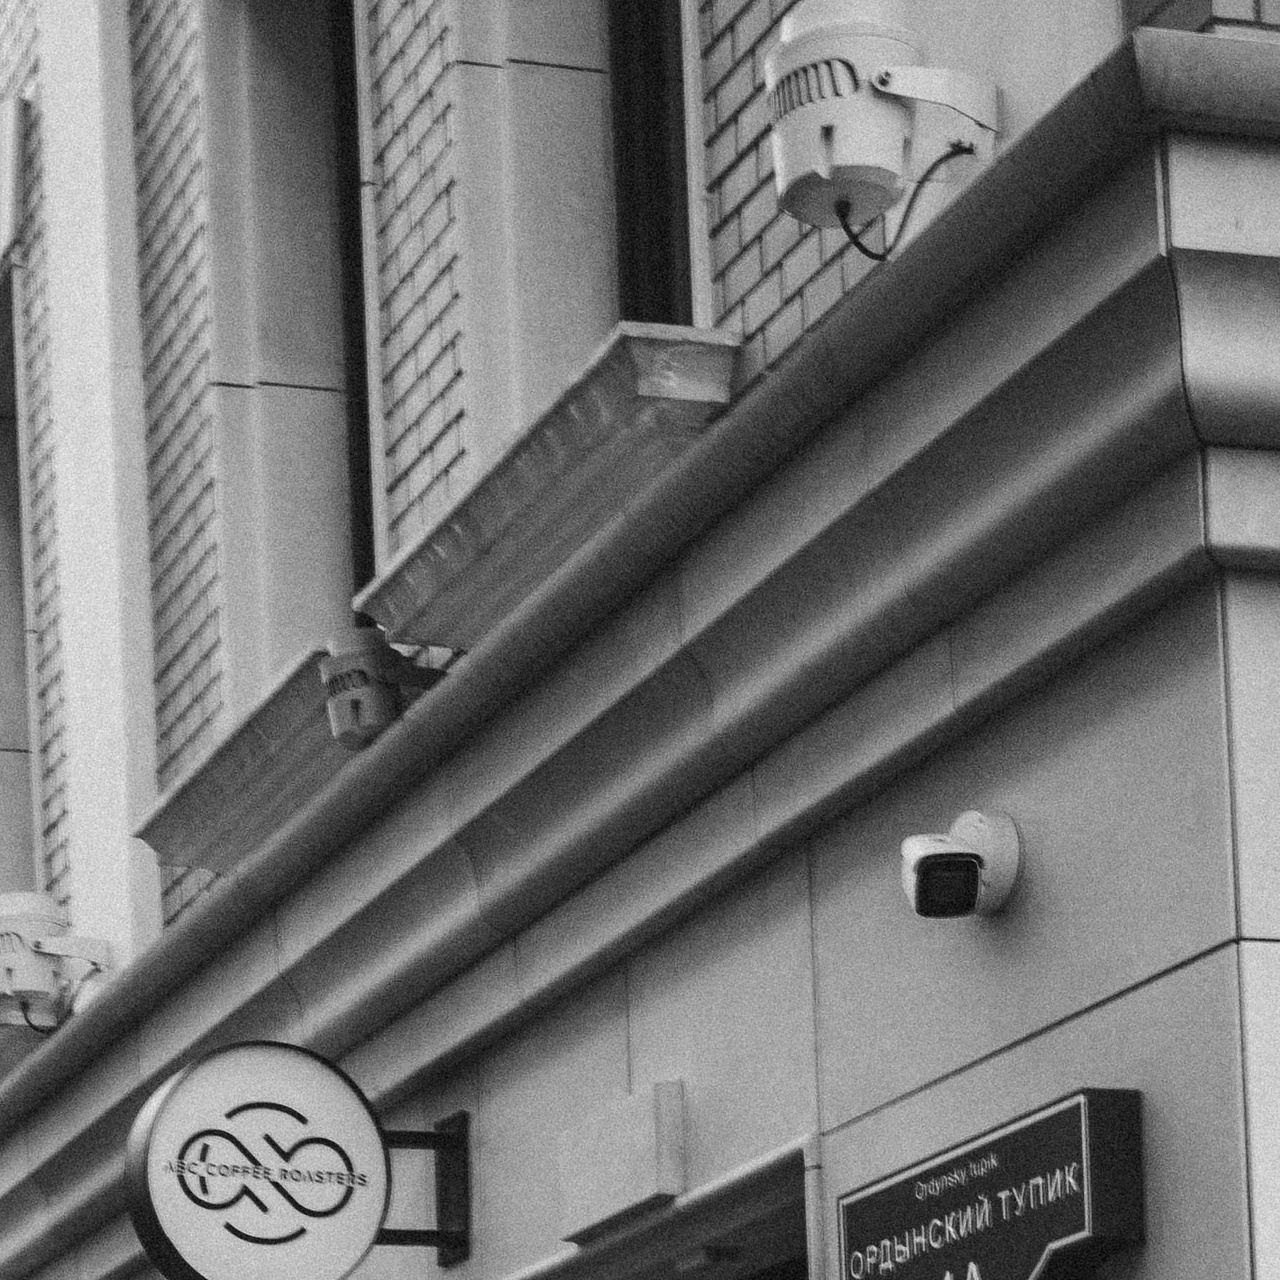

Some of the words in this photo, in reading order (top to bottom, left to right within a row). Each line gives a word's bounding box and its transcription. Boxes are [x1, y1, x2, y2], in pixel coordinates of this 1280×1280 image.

[206, 1162, 272, 1180] COFFEE
[279, 1168, 369, 1187] ROASTERS
[850, 1194, 992, 1280] ОРДЫНСКИЙ
[997, 1163, 1080, 1221] ТУПИК
